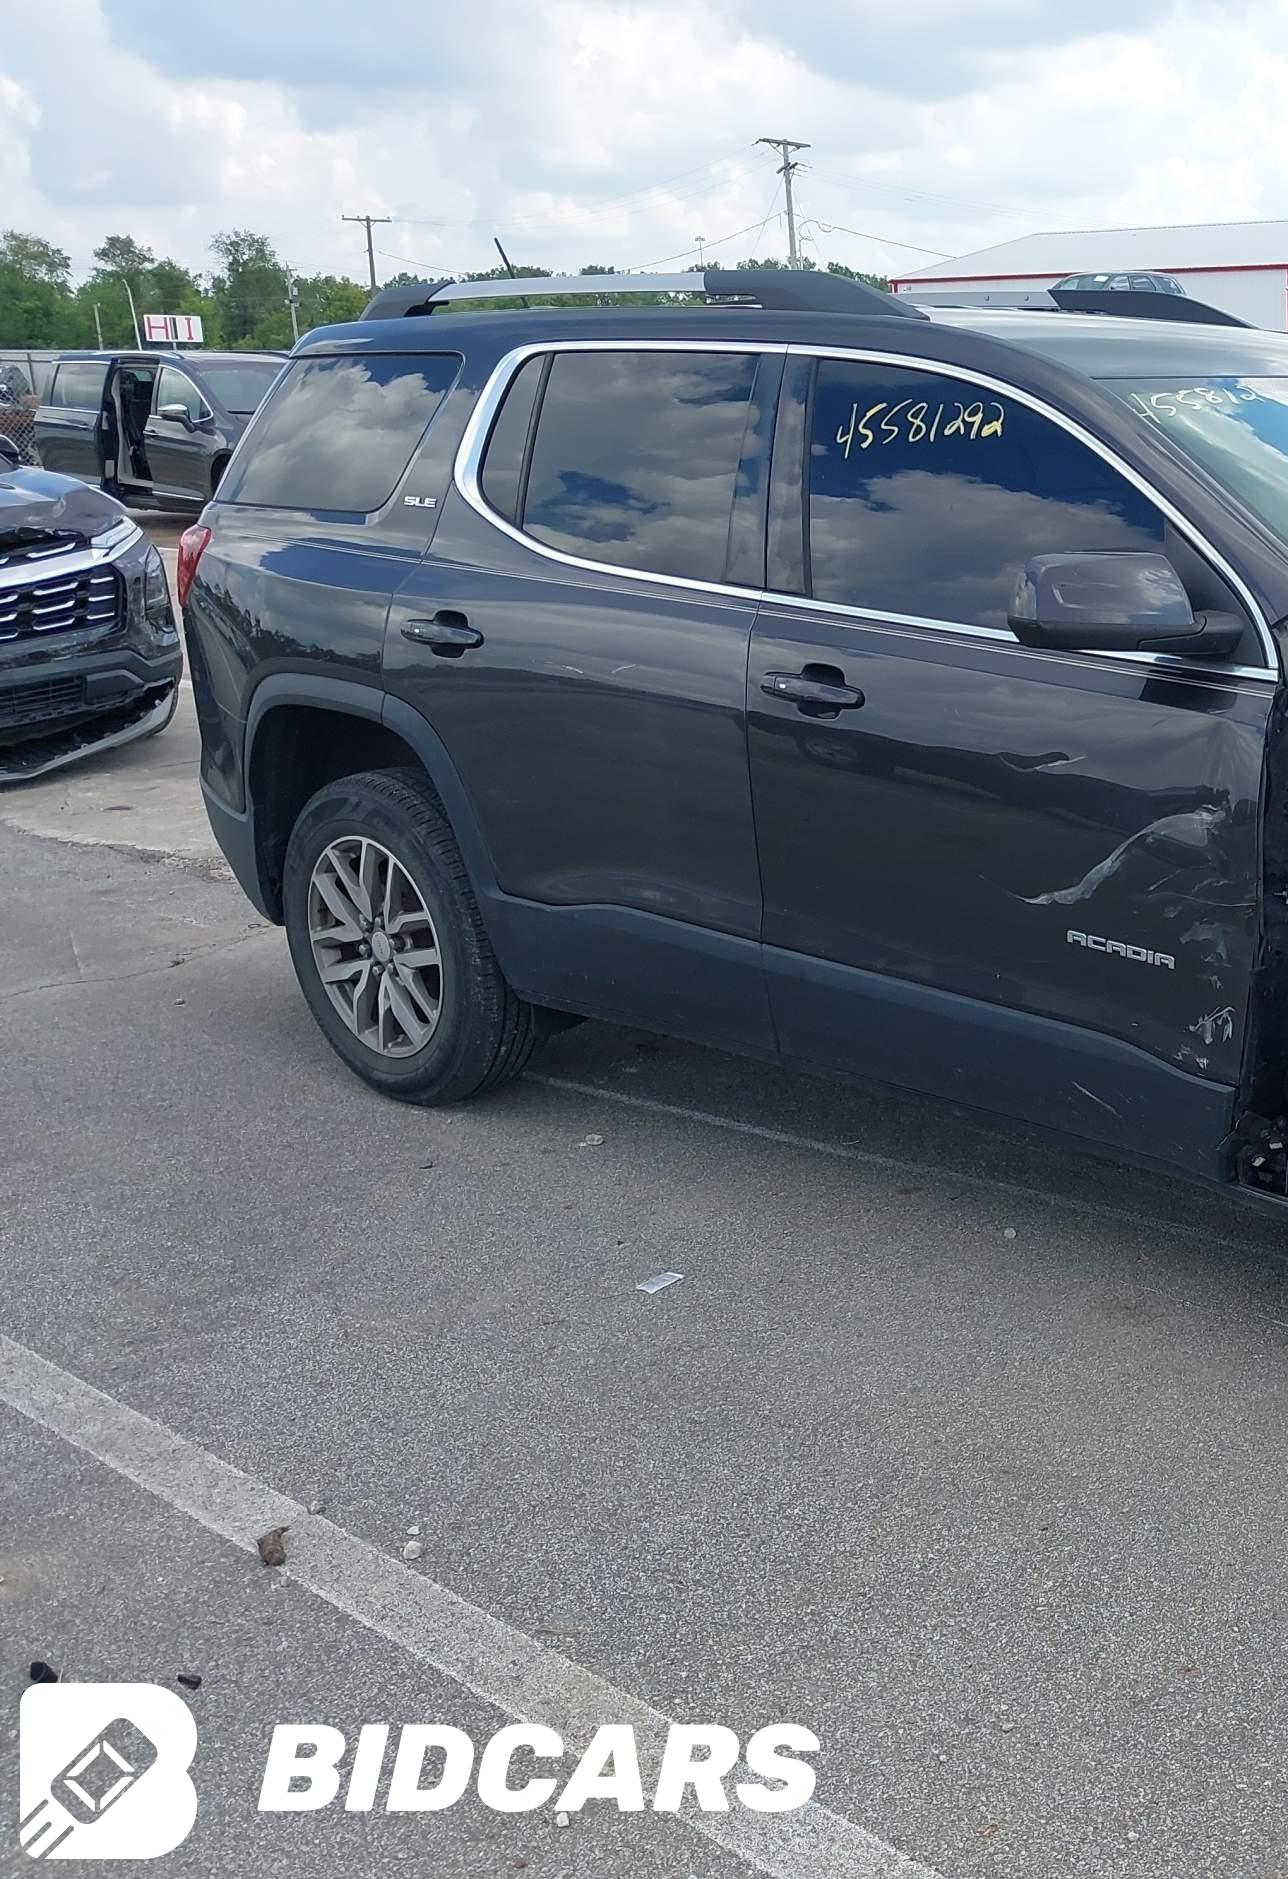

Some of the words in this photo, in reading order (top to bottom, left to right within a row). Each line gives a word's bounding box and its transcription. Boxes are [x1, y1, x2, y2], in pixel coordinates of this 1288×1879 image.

[836, 399, 1004, 459] 45581292
[404, 495, 436, 508] SLE
[1066, 929, 1175, 969] ACADIA
